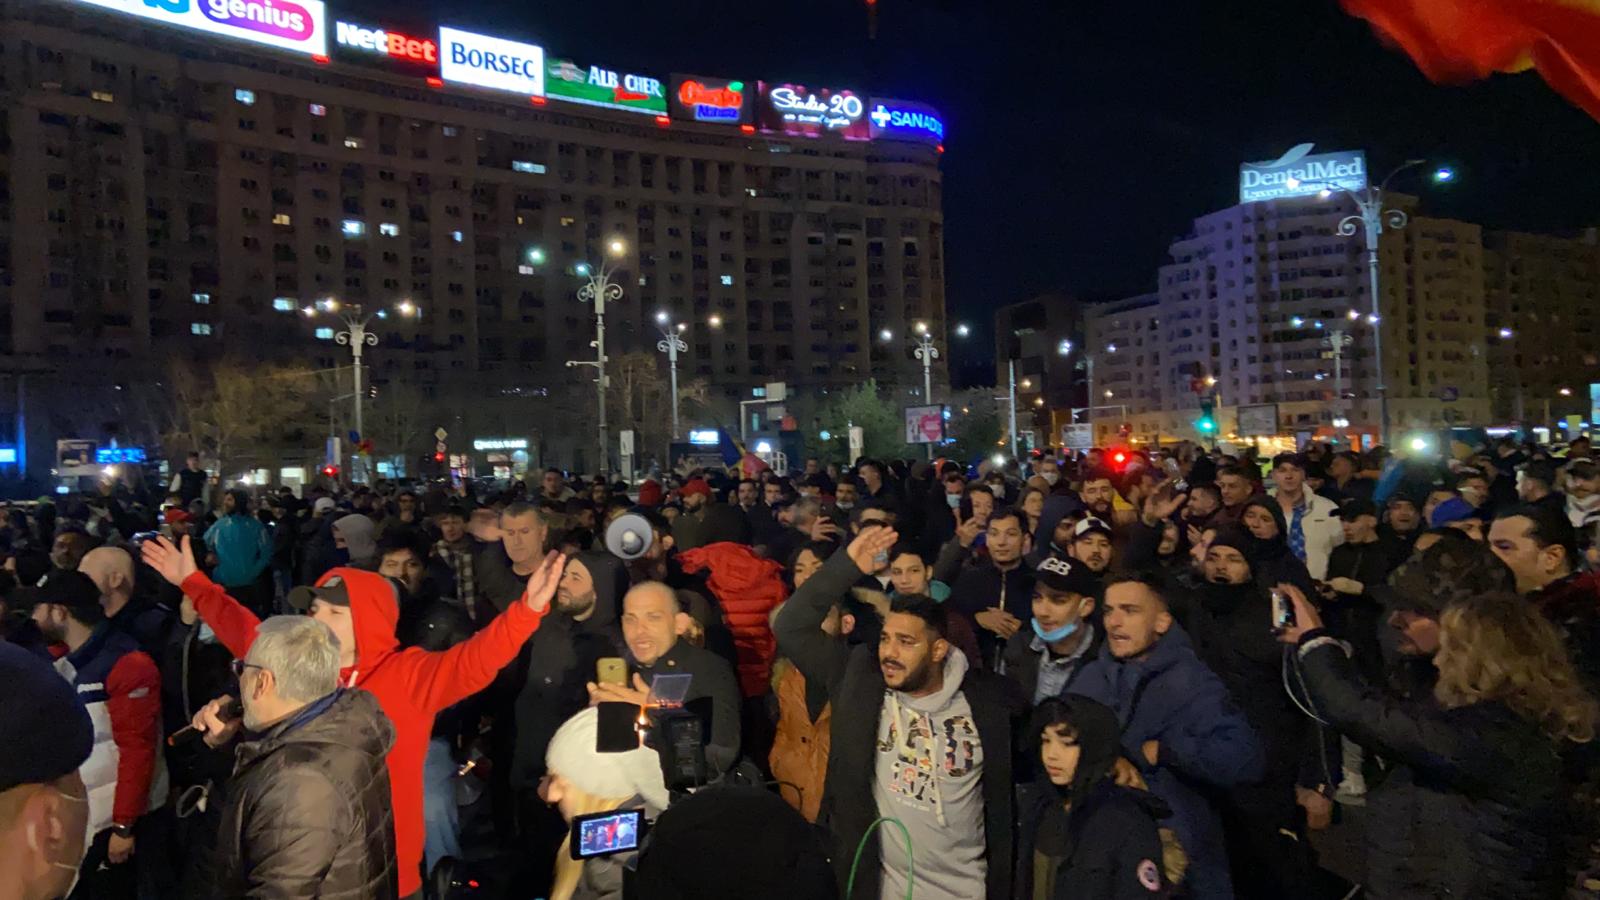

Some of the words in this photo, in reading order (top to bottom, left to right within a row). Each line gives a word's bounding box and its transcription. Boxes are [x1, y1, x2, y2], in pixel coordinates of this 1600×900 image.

[206, 0, 305, 33] genius
[336, 21, 436, 62] NetBet
[451, 41, 535, 79] BORSEC
[830, 94, 862, 117] 20
[1242, 157, 1363, 188] DentalMed
